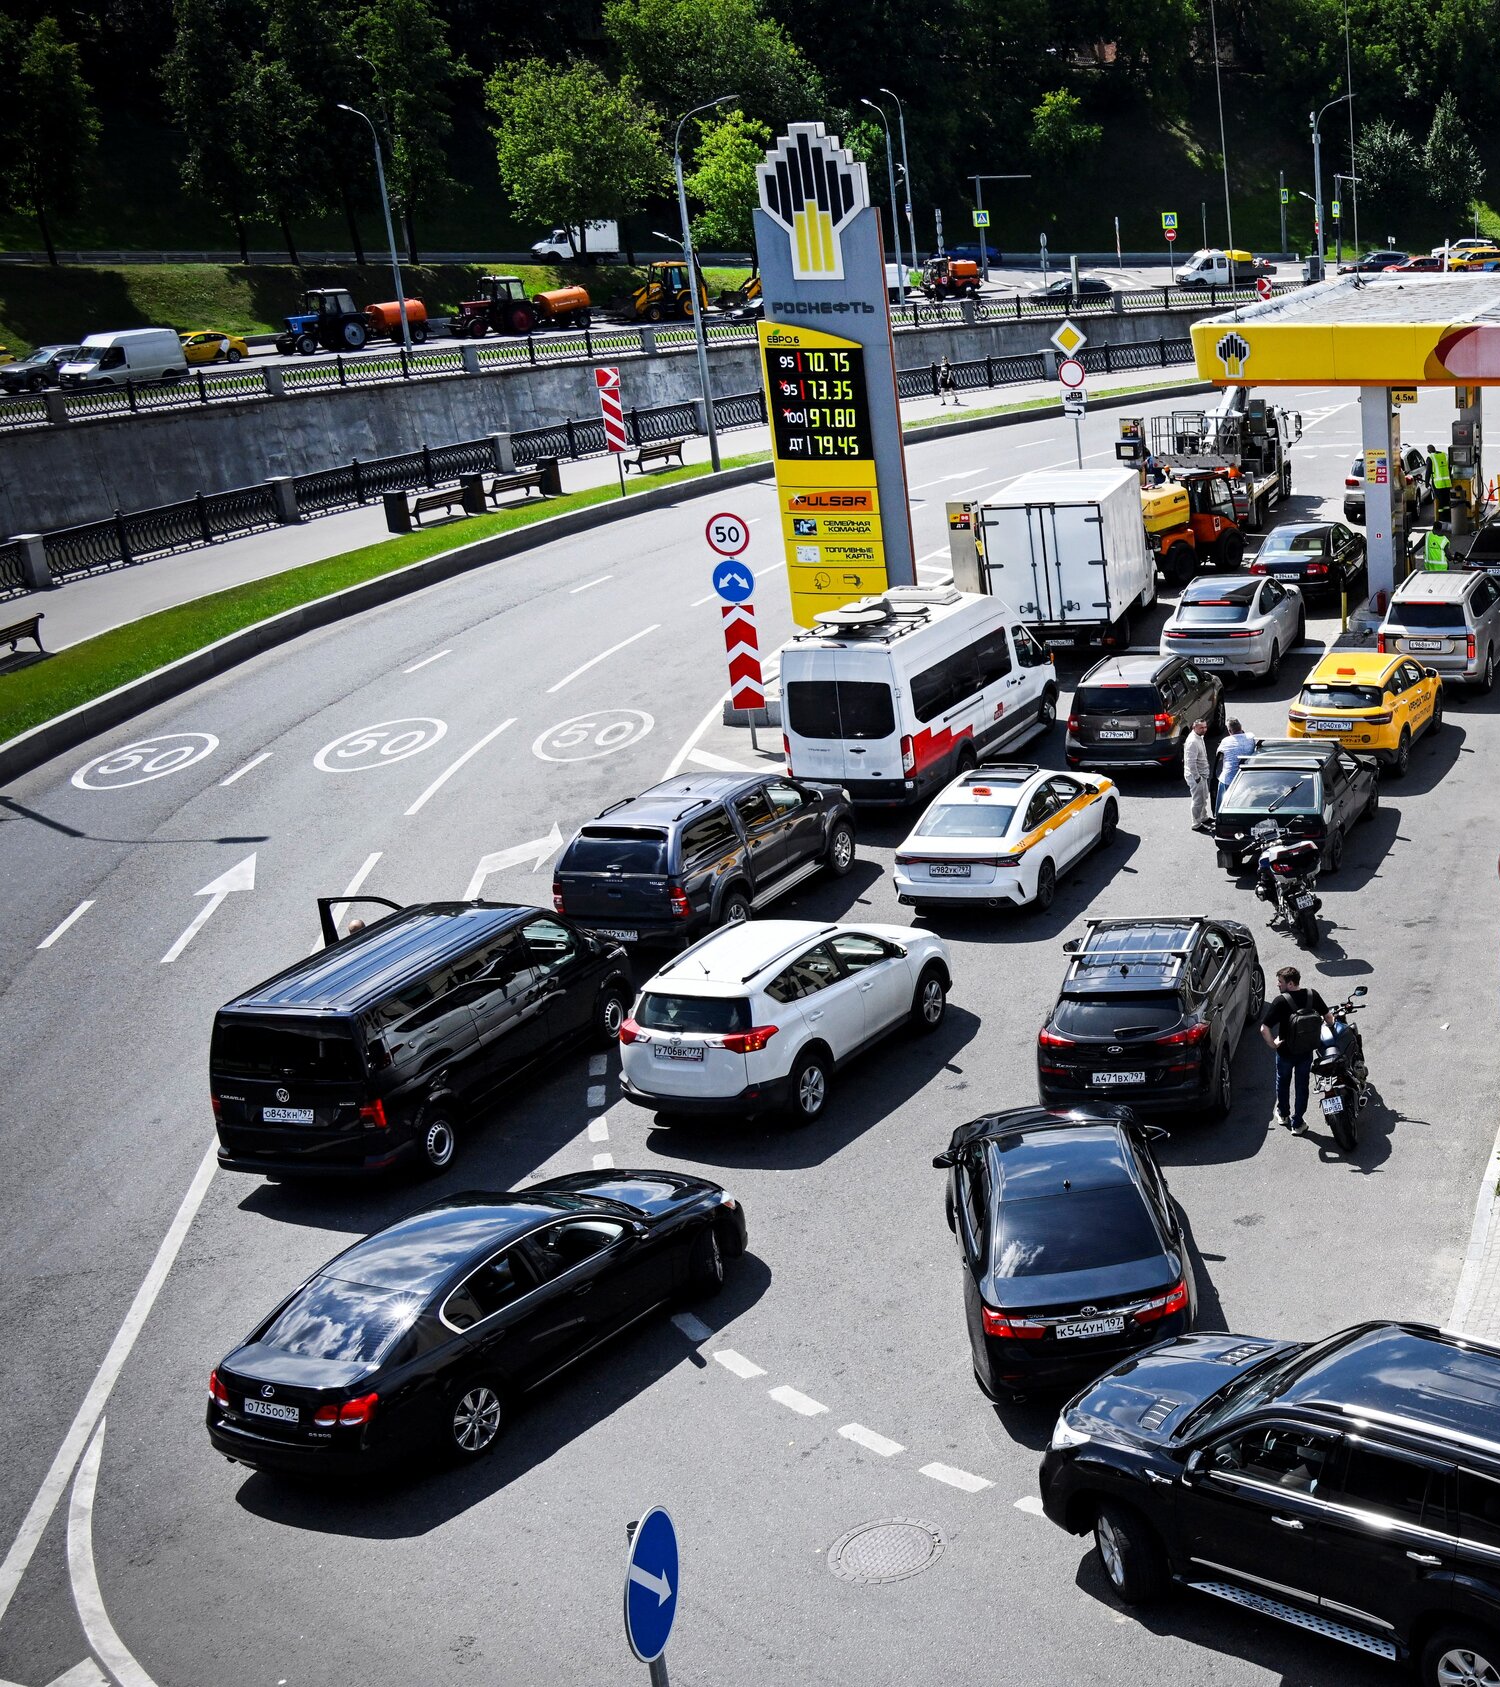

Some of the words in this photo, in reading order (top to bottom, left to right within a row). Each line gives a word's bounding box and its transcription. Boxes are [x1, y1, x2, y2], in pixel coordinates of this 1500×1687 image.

[771, 301, 875, 315] РОСНЕФТЬ
[766, 335, 792, 344] ЕВРО
[793, 335, 800, 344] 6
[779, 356, 795, 368] 95
[804, 352, 850, 372] 70.75
[782, 384, 798, 396] 95
[807, 380, 853, 400] 73.35
[785, 412, 804, 424] 100
[809, 408, 856, 428] 97.80
[789, 438, 804, 451] ДТ
[814, 436, 859, 455] 79.45
[963, 503, 972, 513] 5
[823, 519, 871, 527] СЕМЕЙНАЯ
[715, 526, 740, 544] 50
[337, 731, 426, 758] 50
[552, 722, 634, 748] 50
[98, 747, 195, 774] 50
